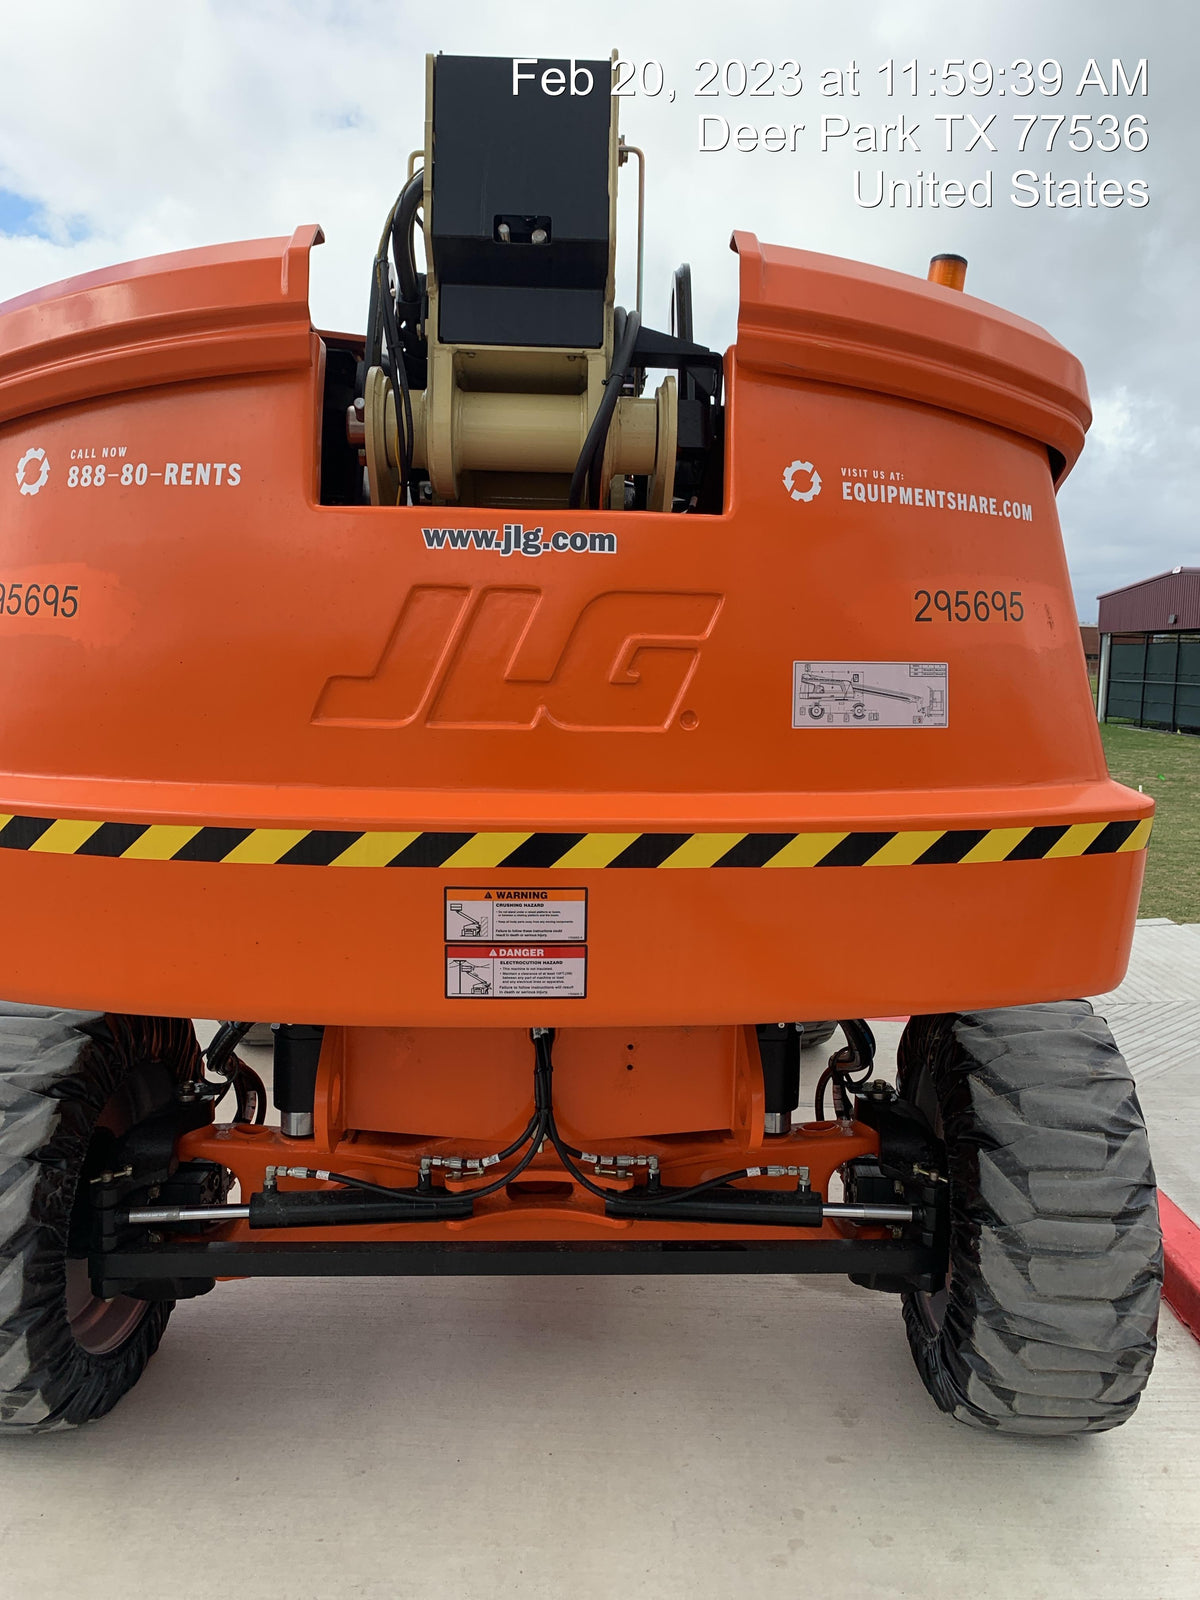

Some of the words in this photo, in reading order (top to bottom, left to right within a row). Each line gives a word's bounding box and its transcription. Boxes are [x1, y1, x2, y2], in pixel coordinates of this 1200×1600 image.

[70, 449, 97, 460] CALL
[102, 446, 128, 458] NOW
[67, 462, 242, 488] 888-80-RENTS
[841, 467, 868, 478] VISIT
[872, 469, 885, 480] US
[889, 471, 904, 481] AT:
[842, 481, 1033, 522] EQUIPMENTSHARE.COM
[422, 524, 617, 557] www.jlg.com
[914, 589, 1025, 622] 295695
[310, 583, 726, 733] JLG
[496, 891, 548, 900] WARNING
[499, 948, 545, 957] DANGER
